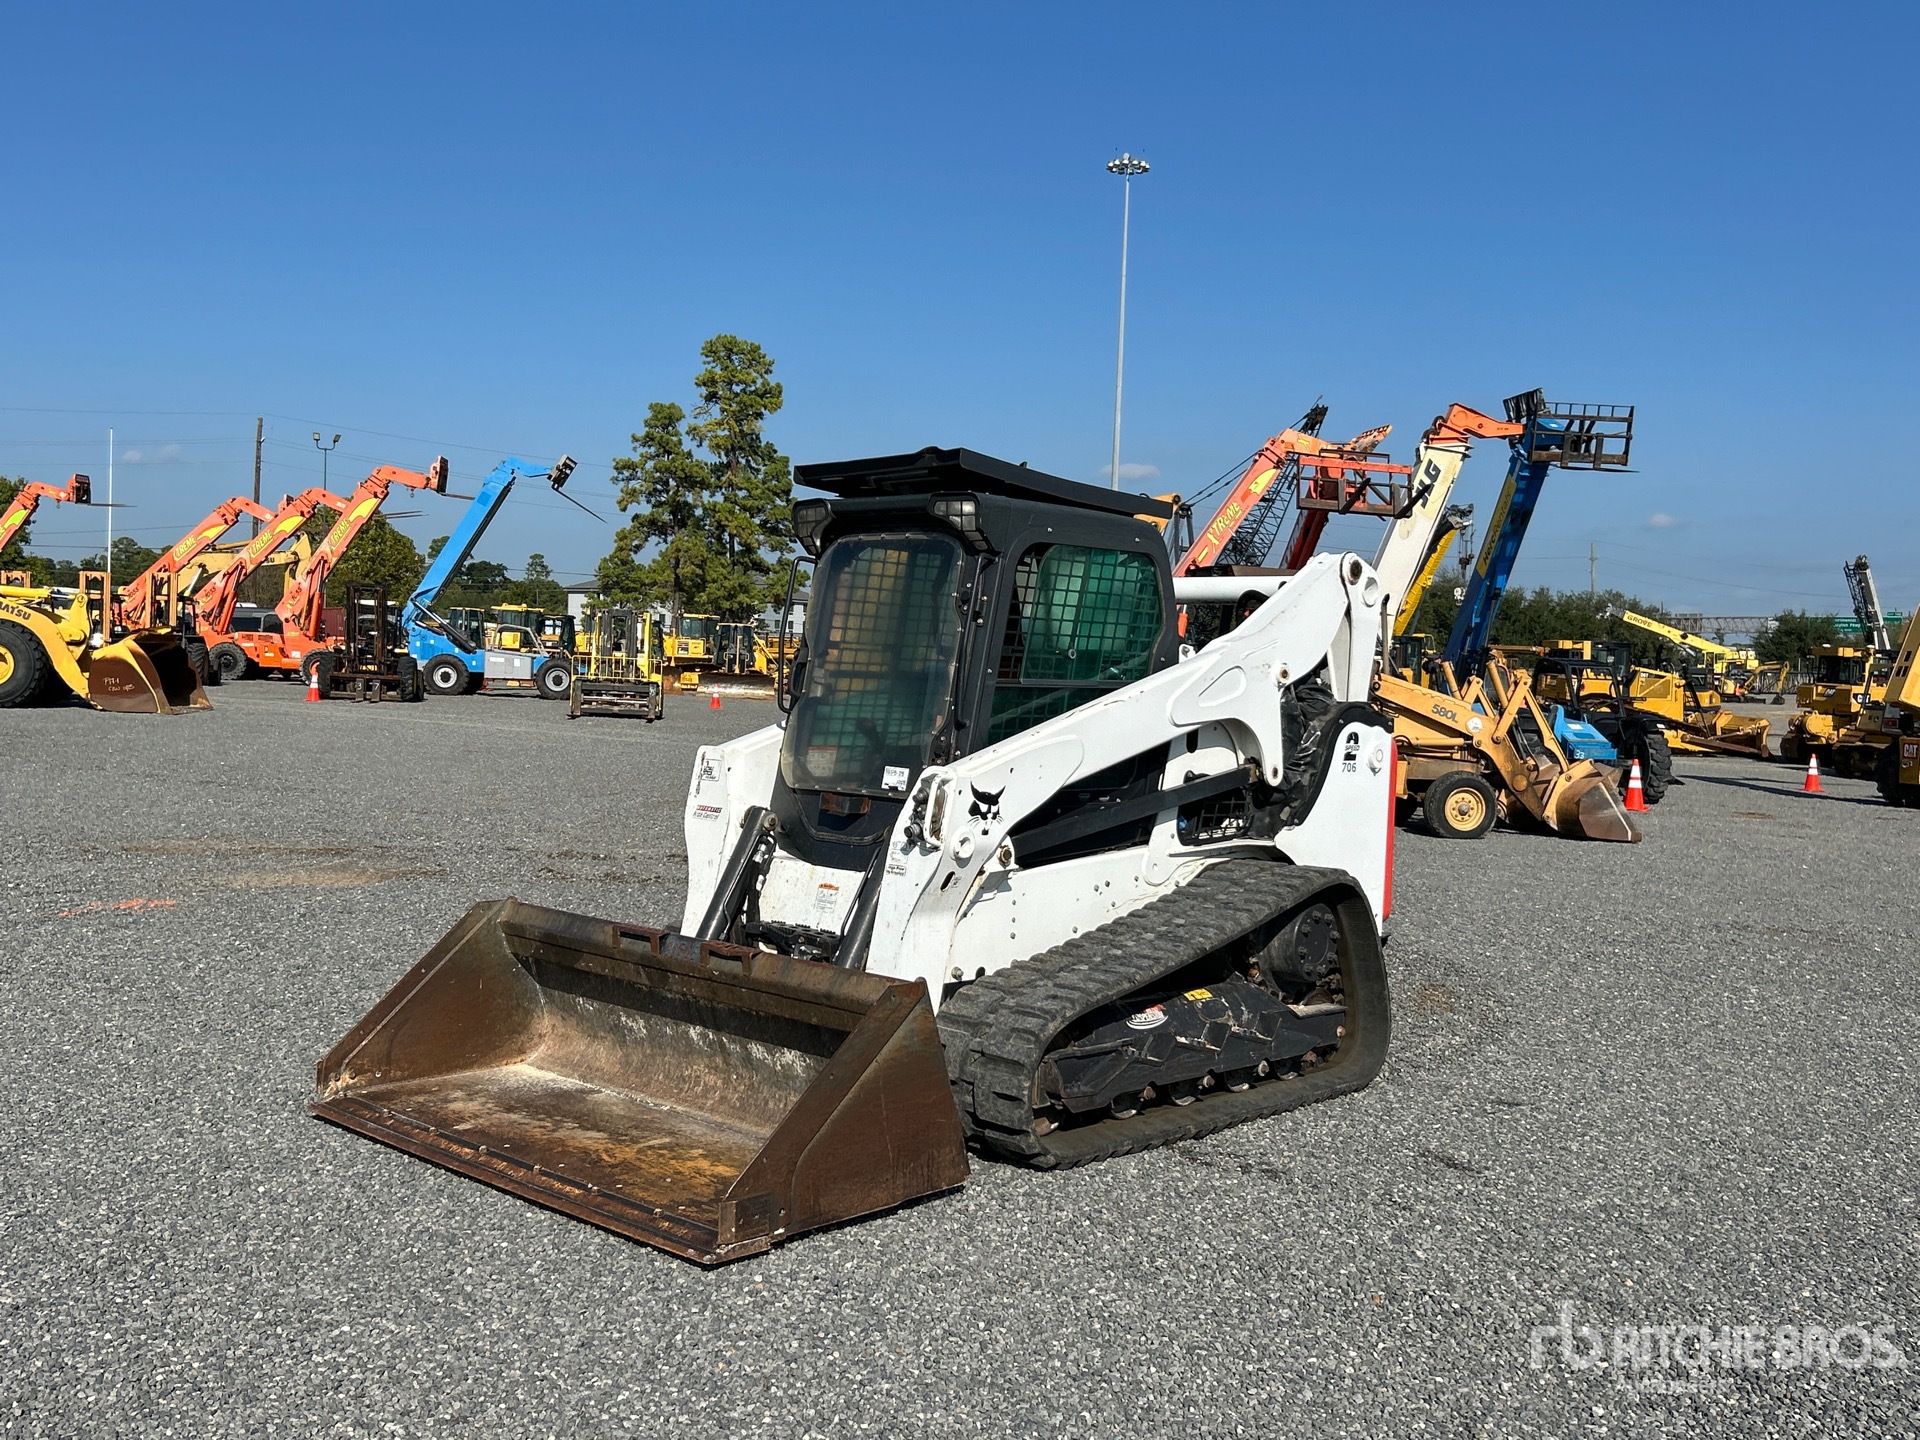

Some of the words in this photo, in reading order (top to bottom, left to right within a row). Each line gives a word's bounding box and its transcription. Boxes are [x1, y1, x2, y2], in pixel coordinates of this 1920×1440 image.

[1627, 615, 1652, 628] GROVE
[1431, 704, 1459, 723] 580L
[1344, 744, 1361, 752] SPEED
[1903, 744, 1918, 758] CAT
[1341, 763, 1357, 773] 706
